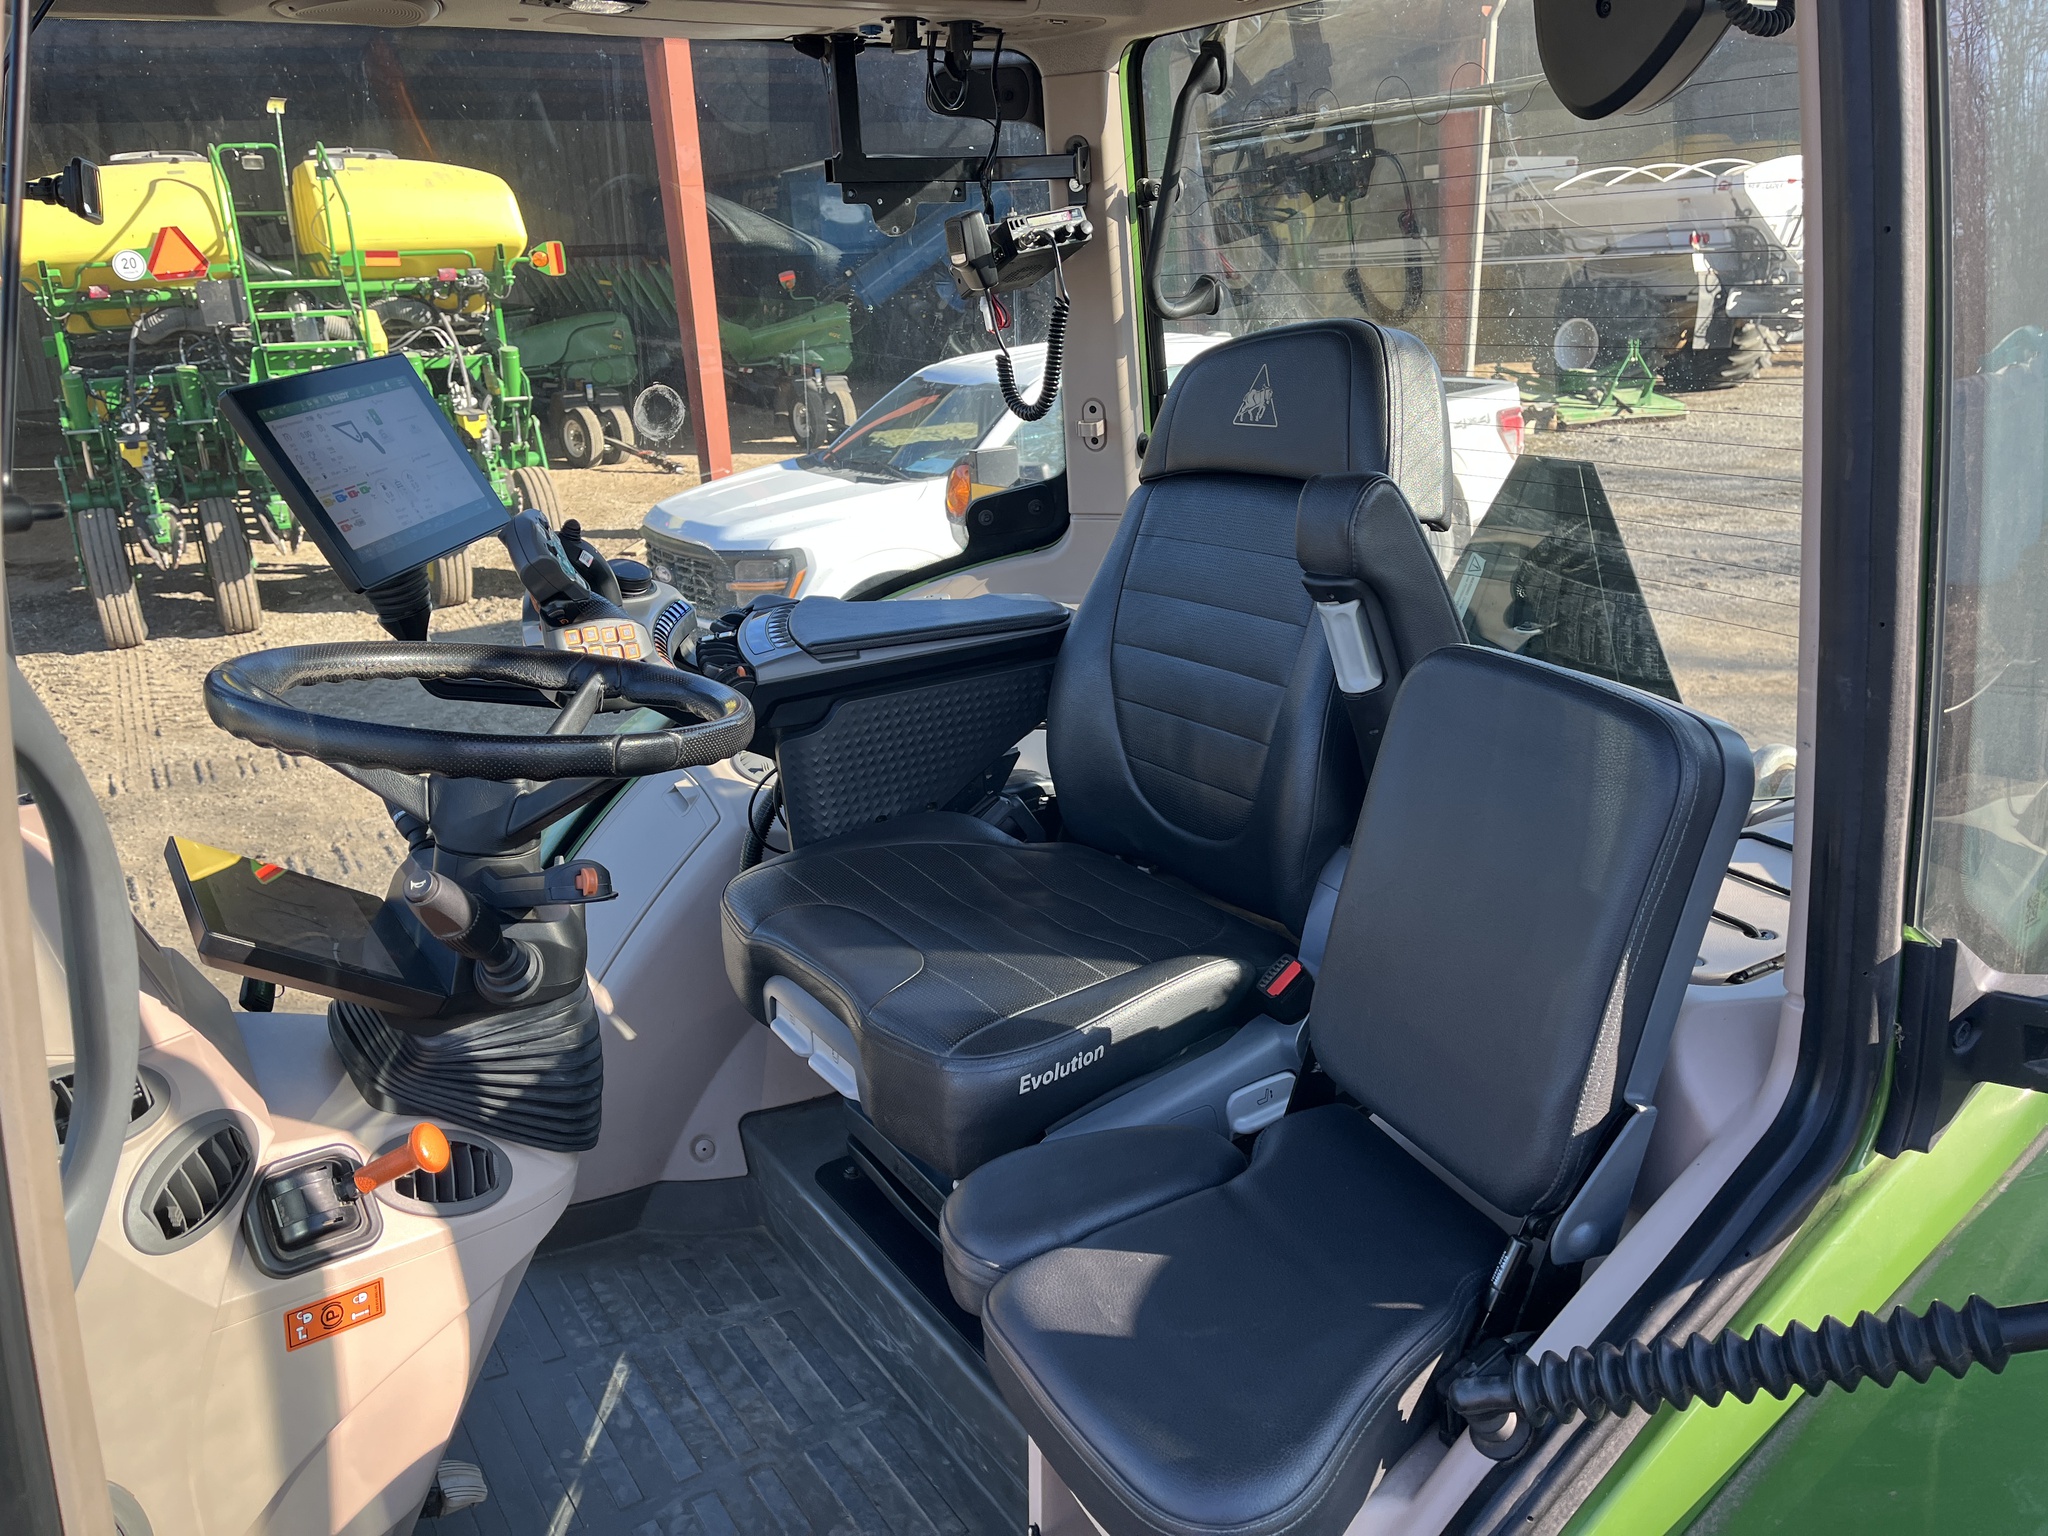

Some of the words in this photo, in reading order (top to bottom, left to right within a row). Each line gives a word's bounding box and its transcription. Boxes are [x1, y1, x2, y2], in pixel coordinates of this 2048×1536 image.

[121, 257, 137, 270] 20
[327, 391, 349, 403] FENDT
[1019, 1044, 1105, 1095] Evolution
[326, 1309, 340, 1321] P
